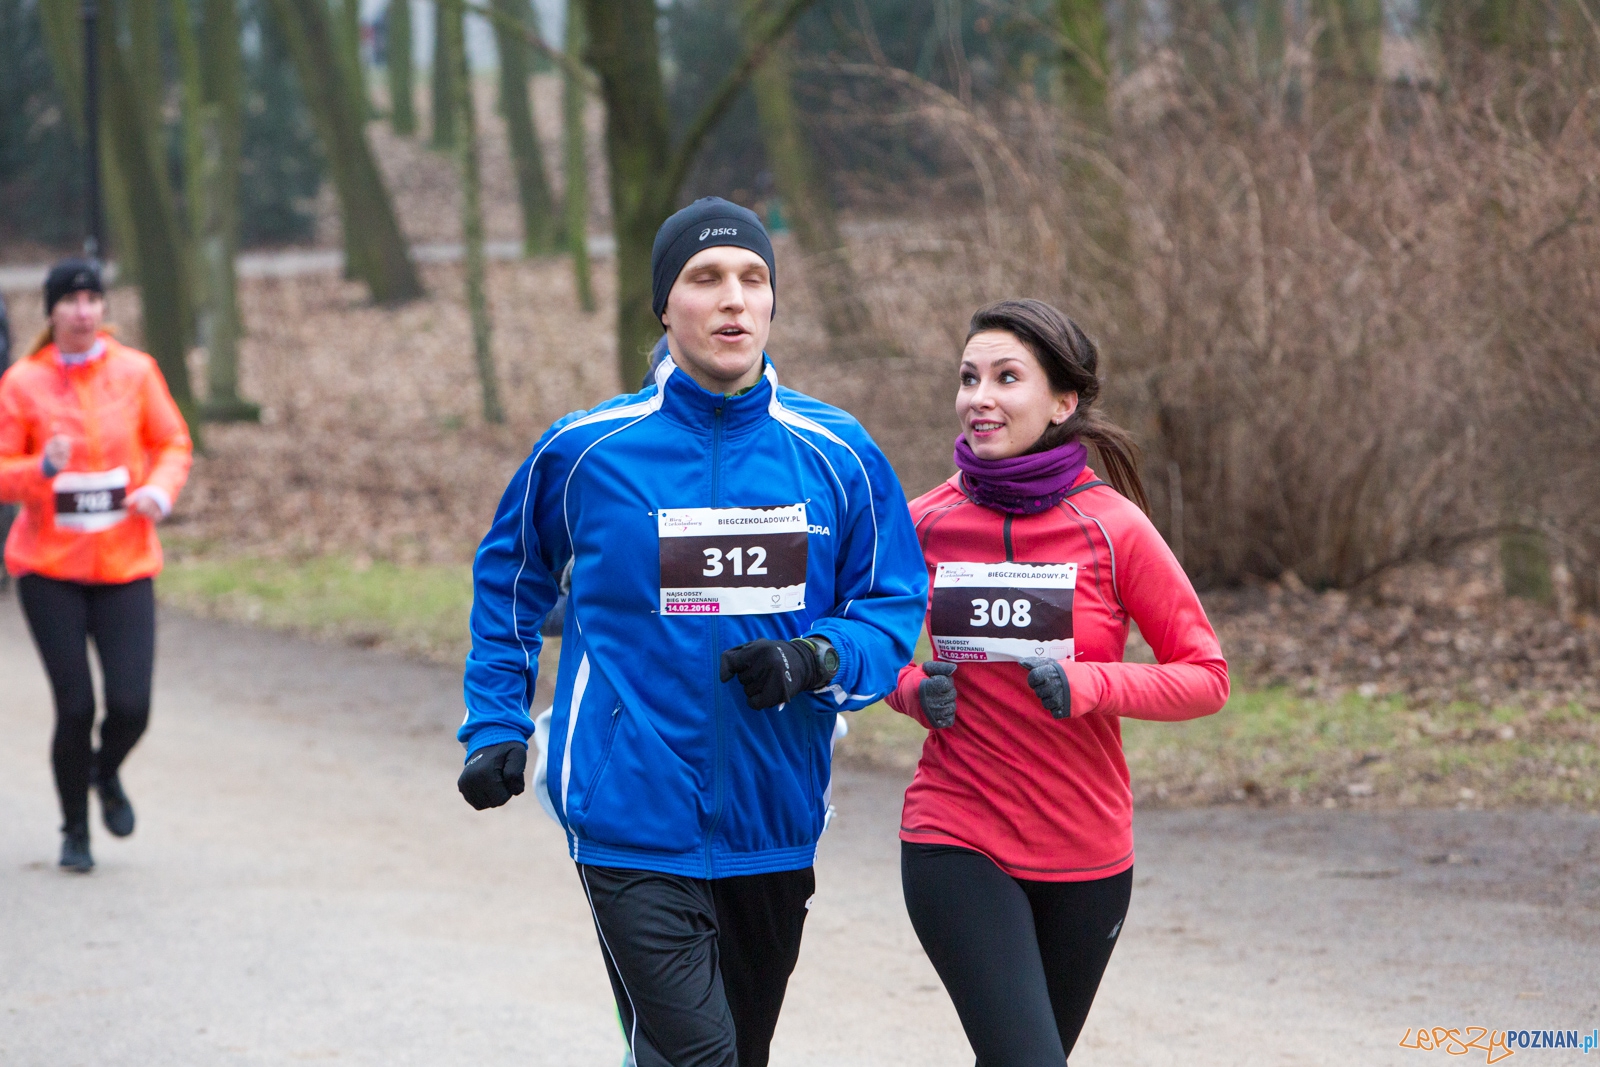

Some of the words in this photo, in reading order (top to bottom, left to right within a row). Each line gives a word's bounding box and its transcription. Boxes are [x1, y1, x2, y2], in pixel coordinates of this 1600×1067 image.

[711, 227, 738, 236] asics
[718, 516, 801, 525] BIEGCZEKOLADOWY.PL
[702, 546, 768, 577] 312
[987, 571, 1069, 580] BIEGCZEKOLADOWY.PL
[668, 604, 711, 612] 14.02.2016
[969, 598, 1032, 628] 308
